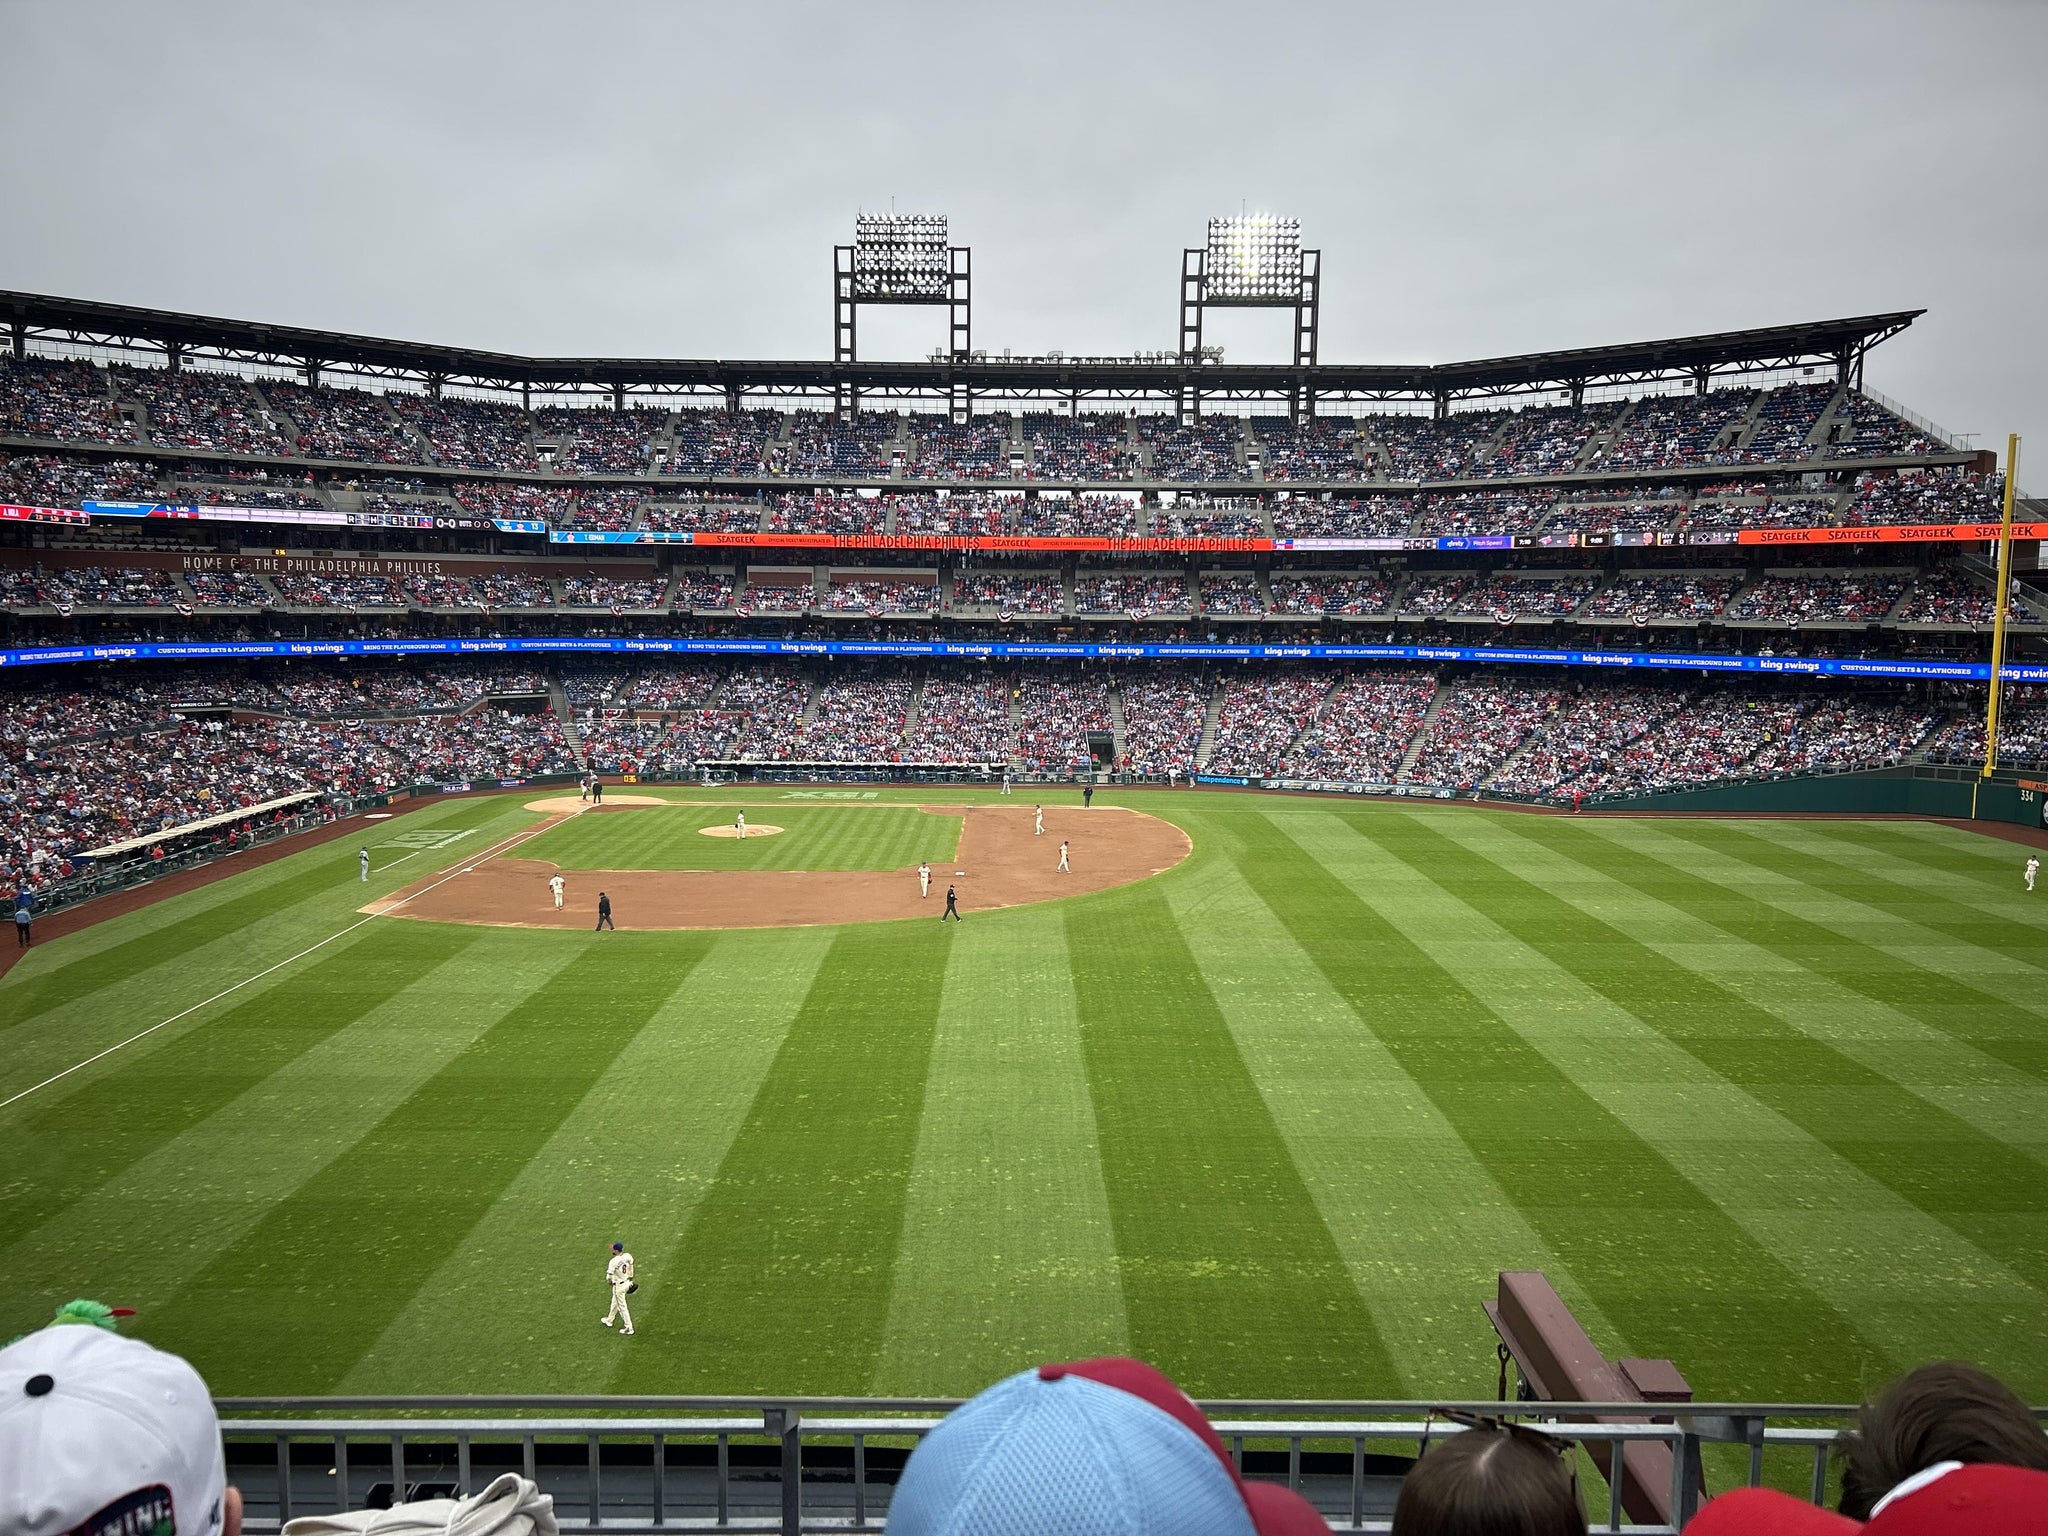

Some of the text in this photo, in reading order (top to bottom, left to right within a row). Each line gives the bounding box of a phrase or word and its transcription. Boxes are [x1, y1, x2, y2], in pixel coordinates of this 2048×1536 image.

[1761, 531, 1811, 542] SEATGEEK
[1828, 529, 1881, 540] SEATGEEK
[1900, 528, 1955, 539] SEATGEEK
[1975, 526, 2034, 537] SEATEEK
[717, 535, 755, 543] SEATGEEK
[833, 534, 852, 547] THE
[855, 535, 931, 549] PHILADELPHIA
[935, 535, 980, 549] PHILLIES
[992, 538, 1031, 547] SEATGEEK
[1107, 538, 1126, 550] THE
[1129, 538, 1206, 550] PHILADELPHIA
[1209, 538, 1255, 550] PHILLIES
[184, 556, 222, 569] HOME
[255, 558, 279, 570] THE
[287, 559, 380, 573] PHILADELPHIA
[387, 562, 441, 573] PHILLIES
[291, 643, 344, 654] king swings
[461, 641, 507, 651] king swings
[626, 641, 672, 651] king swings
[781, 642, 827, 653] king swings
[946, 645, 992, 655] king swings
[1098, 646, 1144, 656] king swings
[94, 646, 136, 658] king swings
[1264, 647, 1310, 657] king swings
[1418, 648, 1460, 659] king swings
[1582, 653, 1633, 665] king swings
[1760, 660, 1819, 672] king swings
[1922, 667, 1971, 675] PLAYHOUSES
[1197, 775, 1241, 784] Independence
[1270, 781, 1280, 789] 10
[1353, 785, 1362, 793] 10
[1397, 787, 1406, 795] 10
[1440, 790, 1450, 798] 10
[2020, 790, 2034, 802] 334
